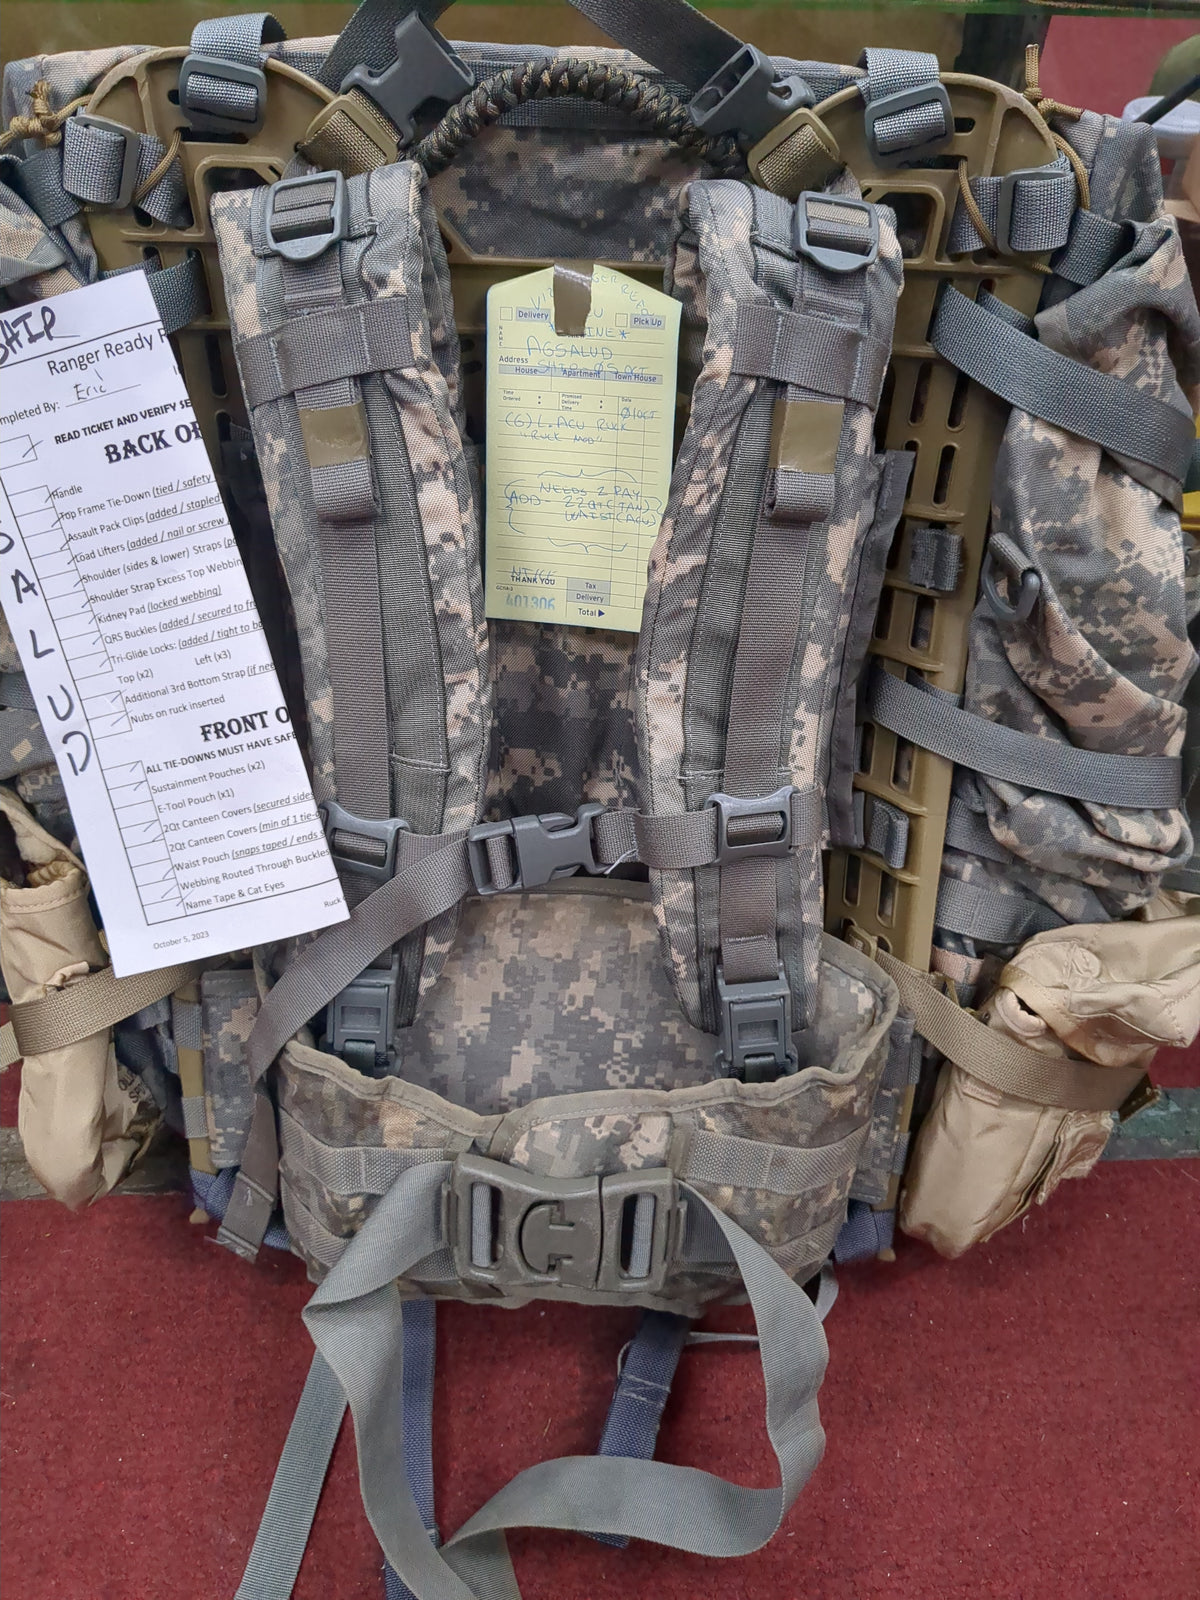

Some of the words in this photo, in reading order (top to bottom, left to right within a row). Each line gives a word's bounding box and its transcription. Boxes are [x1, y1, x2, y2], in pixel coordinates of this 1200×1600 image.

[517, 308, 549, 320] Delivery
[633, 315, 648, 326] Pick
[651, 316, 662, 328] Up
[47, 350, 100, 376] Ranger
[103, 332, 153, 359] Ready
[499, 355, 529, 364] Address
[526, 335, 613, 360] AGSALUD
[515, 366, 538, 375] House
[562, 368, 601, 379] Apartment
[614, 372, 632, 381] Town
[634, 374, 657, 383] House
[73, 376, 107, 401] Eric
[43, 402, 60, 413] By:
[54, 430, 80, 444] READ
[81, 419, 114, 436] TICKET
[117, 413, 138, 427] AND
[139, 402, 176, 419] VERIFY
[104, 429, 172, 464] BACK
[51, 485, 83, 500] Handle
[59, 511, 76, 520] Top
[77, 503, 106, 516] Frame
[106, 491, 151, 508] Tie-Down
[152, 482, 174, 497] (tied
[182, 474, 213, 489] safety
[614, 485, 641, 498] PAY
[67, 527, 99, 543] Assault
[99, 520, 121, 533] Pack
[122, 516, 145, 527] Clips
[145, 504, 179, 523] (added
[186, 493, 222, 512] stapled
[74, 550, 96, 563] Load
[97, 544, 125, 557] Lifters
[127, 533, 159, 551] (added
[167, 526, 184, 538] nail
[186, 525, 195, 533] or
[198, 518, 224, 530] screw
[81, 568, 120, 583] Shoulder
[123, 561, 149, 575] (sides
[151, 556, 158, 565] &
[160, 547, 189, 563] lower)
[192, 541, 222, 555] Straps
[89, 588, 128, 604] Shoulder
[130, 581, 155, 594] Strap
[156, 573, 186, 587] Excess
[186, 568, 205, 578] Top
[510, 575, 538, 584] THANK
[540, 577, 556, 586] YOU
[585, 582, 597, 590] Tax
[96, 611, 127, 624] Kidney
[128, 604, 146, 616] Pad
[147, 596, 180, 614] (locked
[180, 585, 222, 605] webbing)
[576, 593, 604, 604] Delivery
[578, 608, 597, 617] Total
[104, 632, 123, 644] QRS
[124, 626, 158, 639] Buckles
[159, 615, 190, 633] (added
[197, 604, 232, 621] secured
[233, 604, 244, 612] to
[110, 649, 148, 664] Tri-Glide
[149, 643, 177, 655] Locks:
[178, 632, 210, 650] (added
[217, 626, 239, 640] tight
[240, 624, 250, 632] to
[194, 654, 213, 666] Left
[214, 649, 231, 663] (x3)
[117, 675, 135, 684] Top
[136, 668, 154, 681] (x2)
[125, 686, 169, 704] Additional
[170, 682, 186, 693] 3rd
[187, 676, 221, 689] Bottom
[221, 670, 246, 681] Strap
[247, 664, 258, 677] (if
[130, 713, 154, 724] Nubs
[155, 710, 168, 718] on
[168, 703, 188, 715] ruck
[188, 694, 225, 710] inserted
[200, 710, 269, 742] FRONT
[146, 764, 162, 774] ALL
[163, 751, 216, 769] TIE-DOWNS
[217, 744, 244, 757] MUST
[246, 737, 272, 750] HAVE
[151, 774, 208, 794] Sustainment
[208, 766, 246, 780] Pouches
[247, 760, 265, 773] (x2)
[157, 799, 186, 813] E-Tool
[187, 793, 216, 806] Pouch
[217, 788, 235, 800] (x1)
[163, 823, 181, 833] 2Qt
[182, 814, 220, 828] Canteen
[221, 806, 252, 819] Covers
[253, 795, 292, 814] (secured
[169, 842, 186, 853] 2Qt
[187, 834, 225, 848] Canteen
[226, 826, 258, 839] Covers
[259, 820, 280, 833] (min
[281, 815, 292, 828] of
[174, 859, 200, 871] Waist
[201, 852, 230, 865] Pouch
[231, 846, 261, 860] (snaps
[262, 837, 289, 853] taped
[296, 831, 318, 844] ends
[180, 876, 221, 890] Webbing
[221, 866, 254, 881] Routed
[255, 857, 294, 873] Through
[295, 847, 331, 864] Buckles
[185, 899, 212, 910] Name
[213, 893, 236, 903] Tape
[238, 889, 245, 897] &
[247, 886, 263, 895] Cat
[264, 881, 285, 892] Eyes
[324, 897, 341, 907] Ruck
[153, 938, 182, 950] October
[191, 930, 210, 941] 2023
